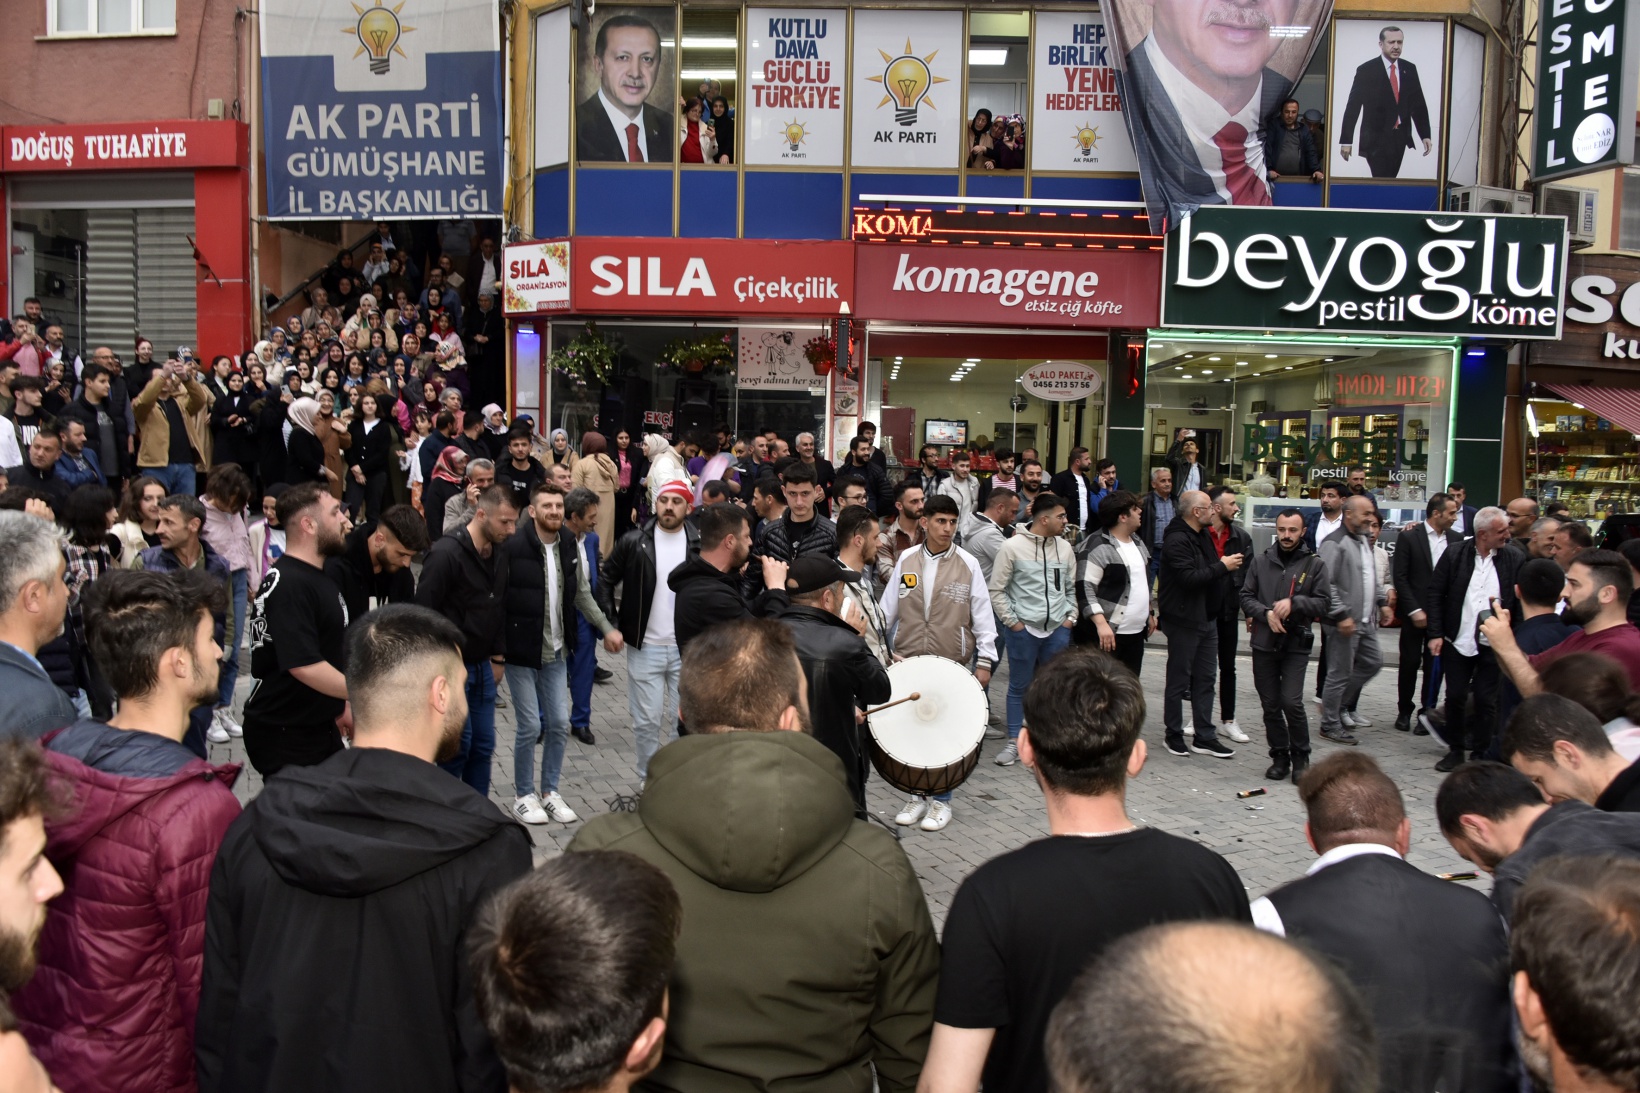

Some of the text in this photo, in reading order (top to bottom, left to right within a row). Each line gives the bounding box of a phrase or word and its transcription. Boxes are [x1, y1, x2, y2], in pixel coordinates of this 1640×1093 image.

[769, 18, 827, 39] KUTLU
[1073, 24, 1106, 44] HEP
[775, 39, 819, 59] DAVA
[763, 59, 831, 84] GÜÇLÜ
[286, 94, 481, 141] AK PARTİ
[11, 127, 187, 166] DOĞUŞ TUHAFİYE
[873, 131, 895, 144] AK
[286, 146, 486, 183] GÜMÜŞHANE
[288, 184, 488, 219] İL BAŞKANLIĞI
[854, 213, 932, 236] KOMA
[510, 258, 550, 279] SILA
[1173, 210, 1555, 320] beyoğlu
[516, 281, 567, 291] ORGANİZASYON
[589, 255, 839, 304] SILA Çiçekçilik
[892, 253, 1099, 307] komagene
[1025, 299, 1123, 317] etsiz çiğ köfte
[1318, 295, 1556, 327] pestil köme
[740, 375, 824, 386] sevgi adına her şey
[1039, 370, 1085, 380] ALO PAKET
[1069, 381, 1079, 389] 57
[1080, 381, 1090, 389] 56
[644, 411, 673, 429] EKÇİ
[1242, 423, 1428, 476] Beyoğlu
[1311, 465, 1427, 483] pestil köme
[1375, 539, 1396, 557] tış
